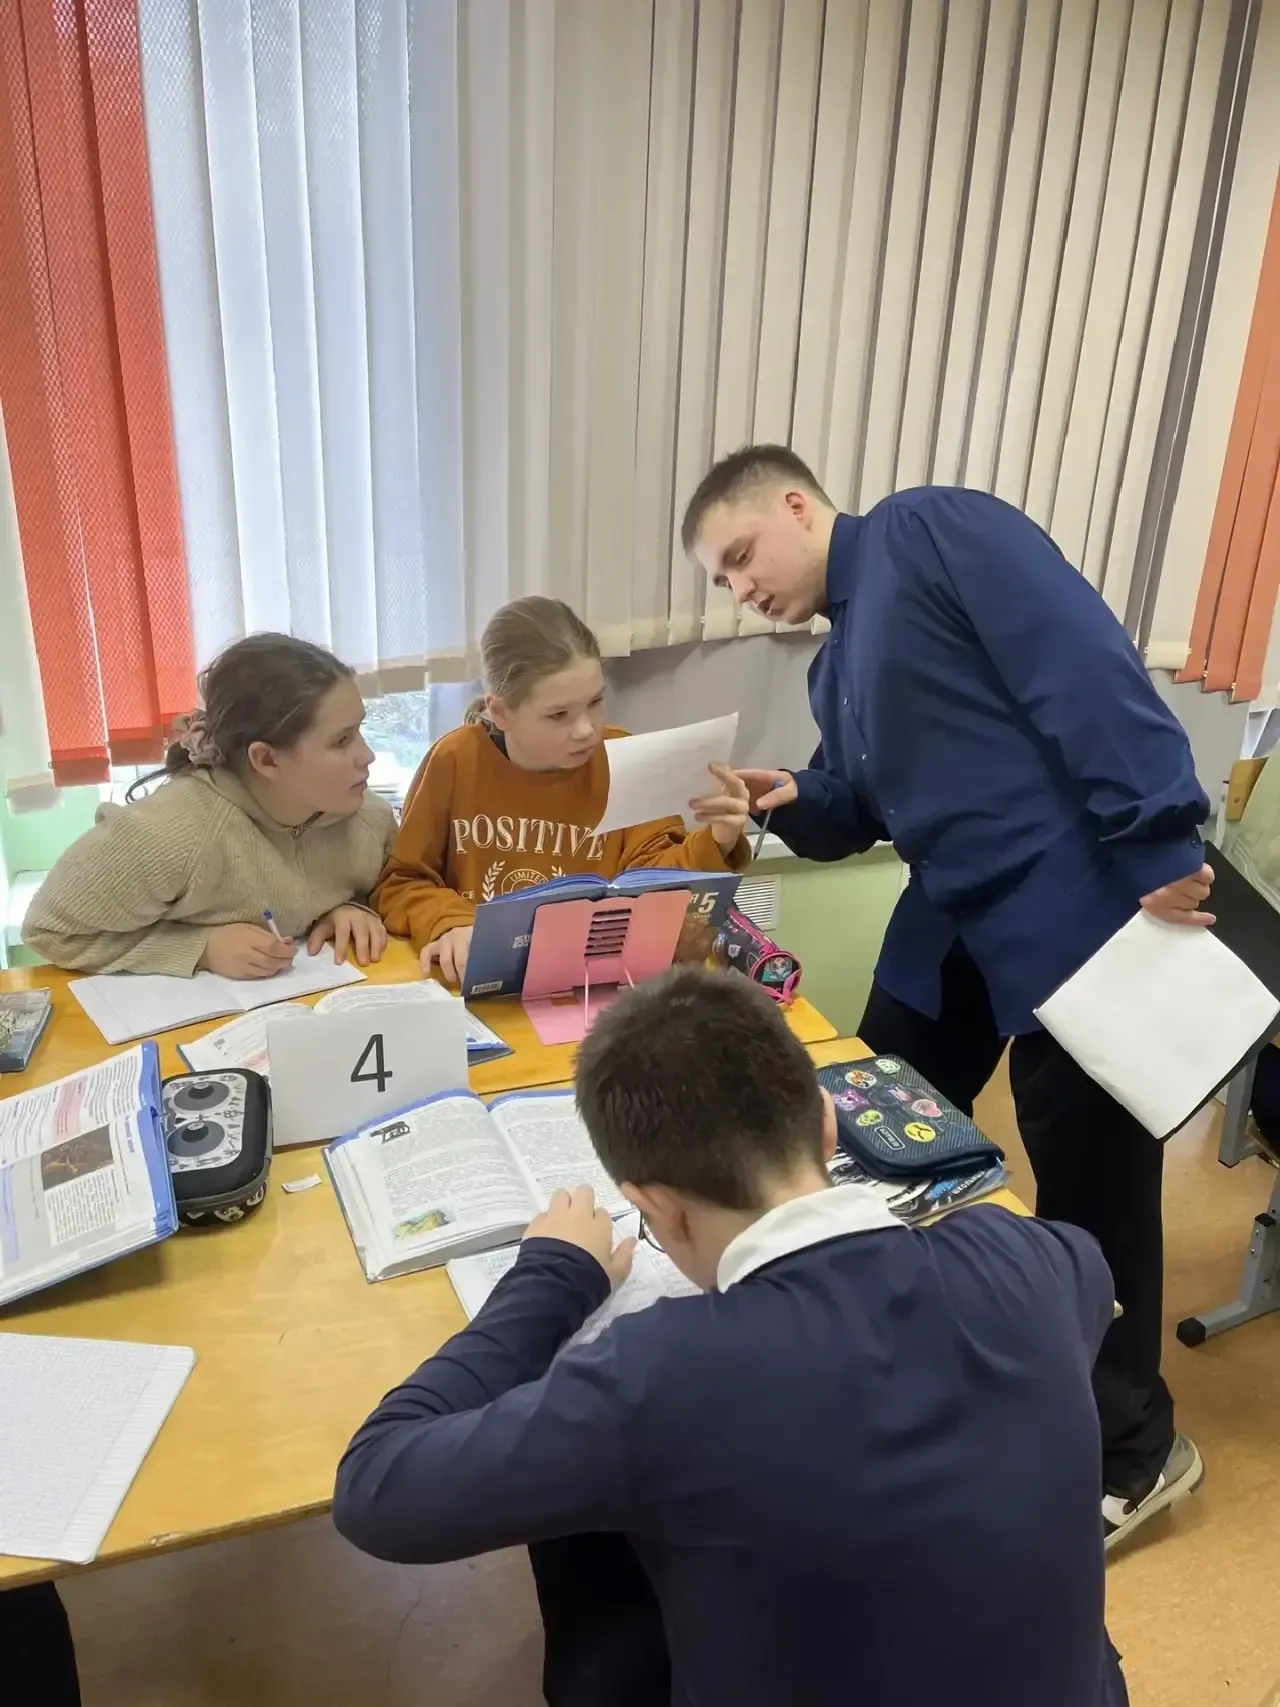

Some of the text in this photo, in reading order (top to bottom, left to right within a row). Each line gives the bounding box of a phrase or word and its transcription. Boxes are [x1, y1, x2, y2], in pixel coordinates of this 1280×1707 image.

[453, 814, 607, 860] POSITIVE
[510, 871, 546, 885] LIMITED
[698, 892, 719, 914] 5
[350, 1033, 393, 1092] 4
